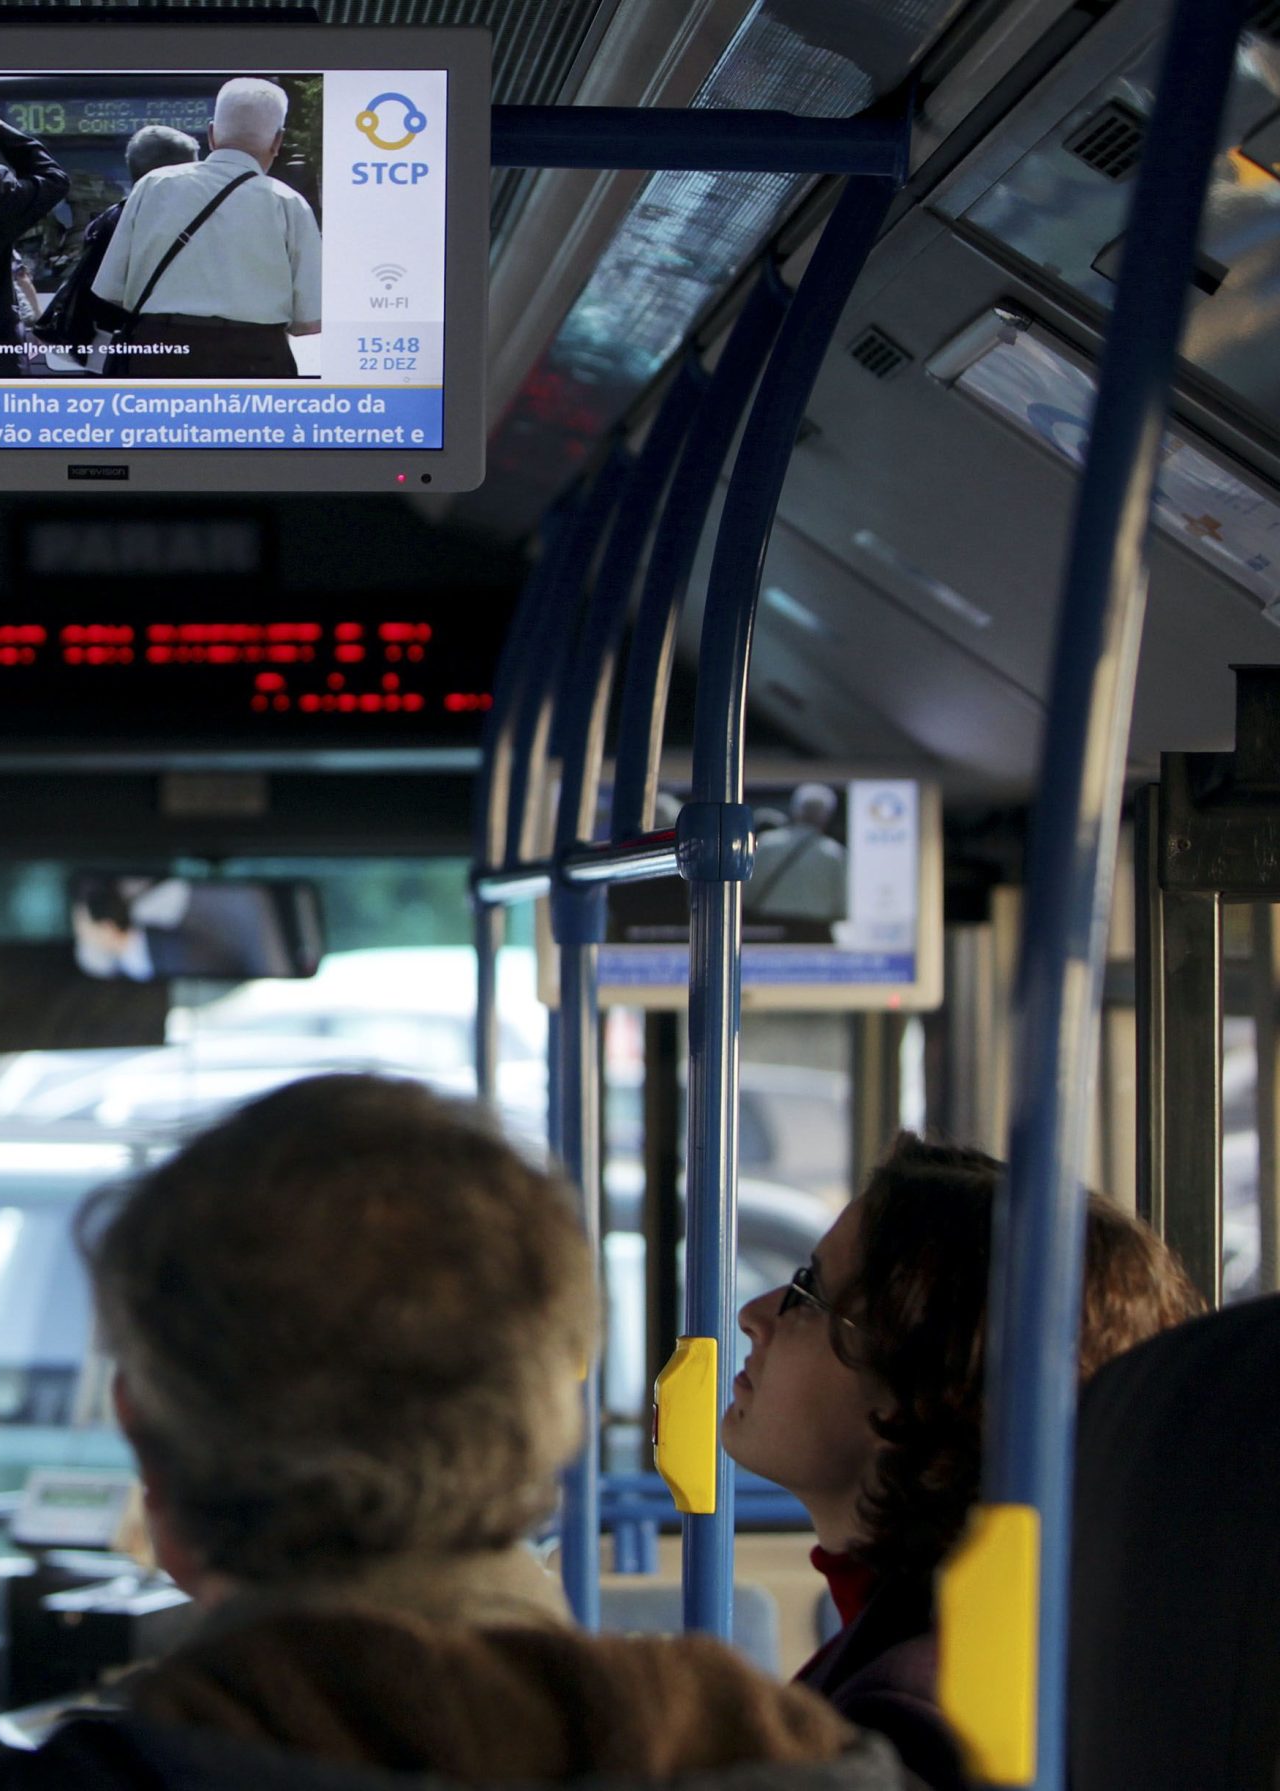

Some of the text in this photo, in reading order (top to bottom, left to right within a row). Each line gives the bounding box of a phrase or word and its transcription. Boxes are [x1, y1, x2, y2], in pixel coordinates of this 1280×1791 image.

[9, 103, 66, 134] 303
[351, 161, 429, 185] STCP
[369, 297, 409, 309] WI-FI
[77, 344, 94, 355] as
[99, 342, 191, 355] estimativas
[357, 337, 421, 353] 15:48
[359, 357, 417, 370] 22 DEZ
[4, 393, 60, 413] linha
[66, 397, 103, 417] 207
[112, 394, 351, 417] (Campanhã/Mercado
[357, 393, 386, 413] da
[38, 424, 114, 443] aceder
[120, 423, 285, 447] gratuitamente
[291, 423, 306, 443] à
[312, 424, 405, 443] internet
[410, 428, 425, 443] e
